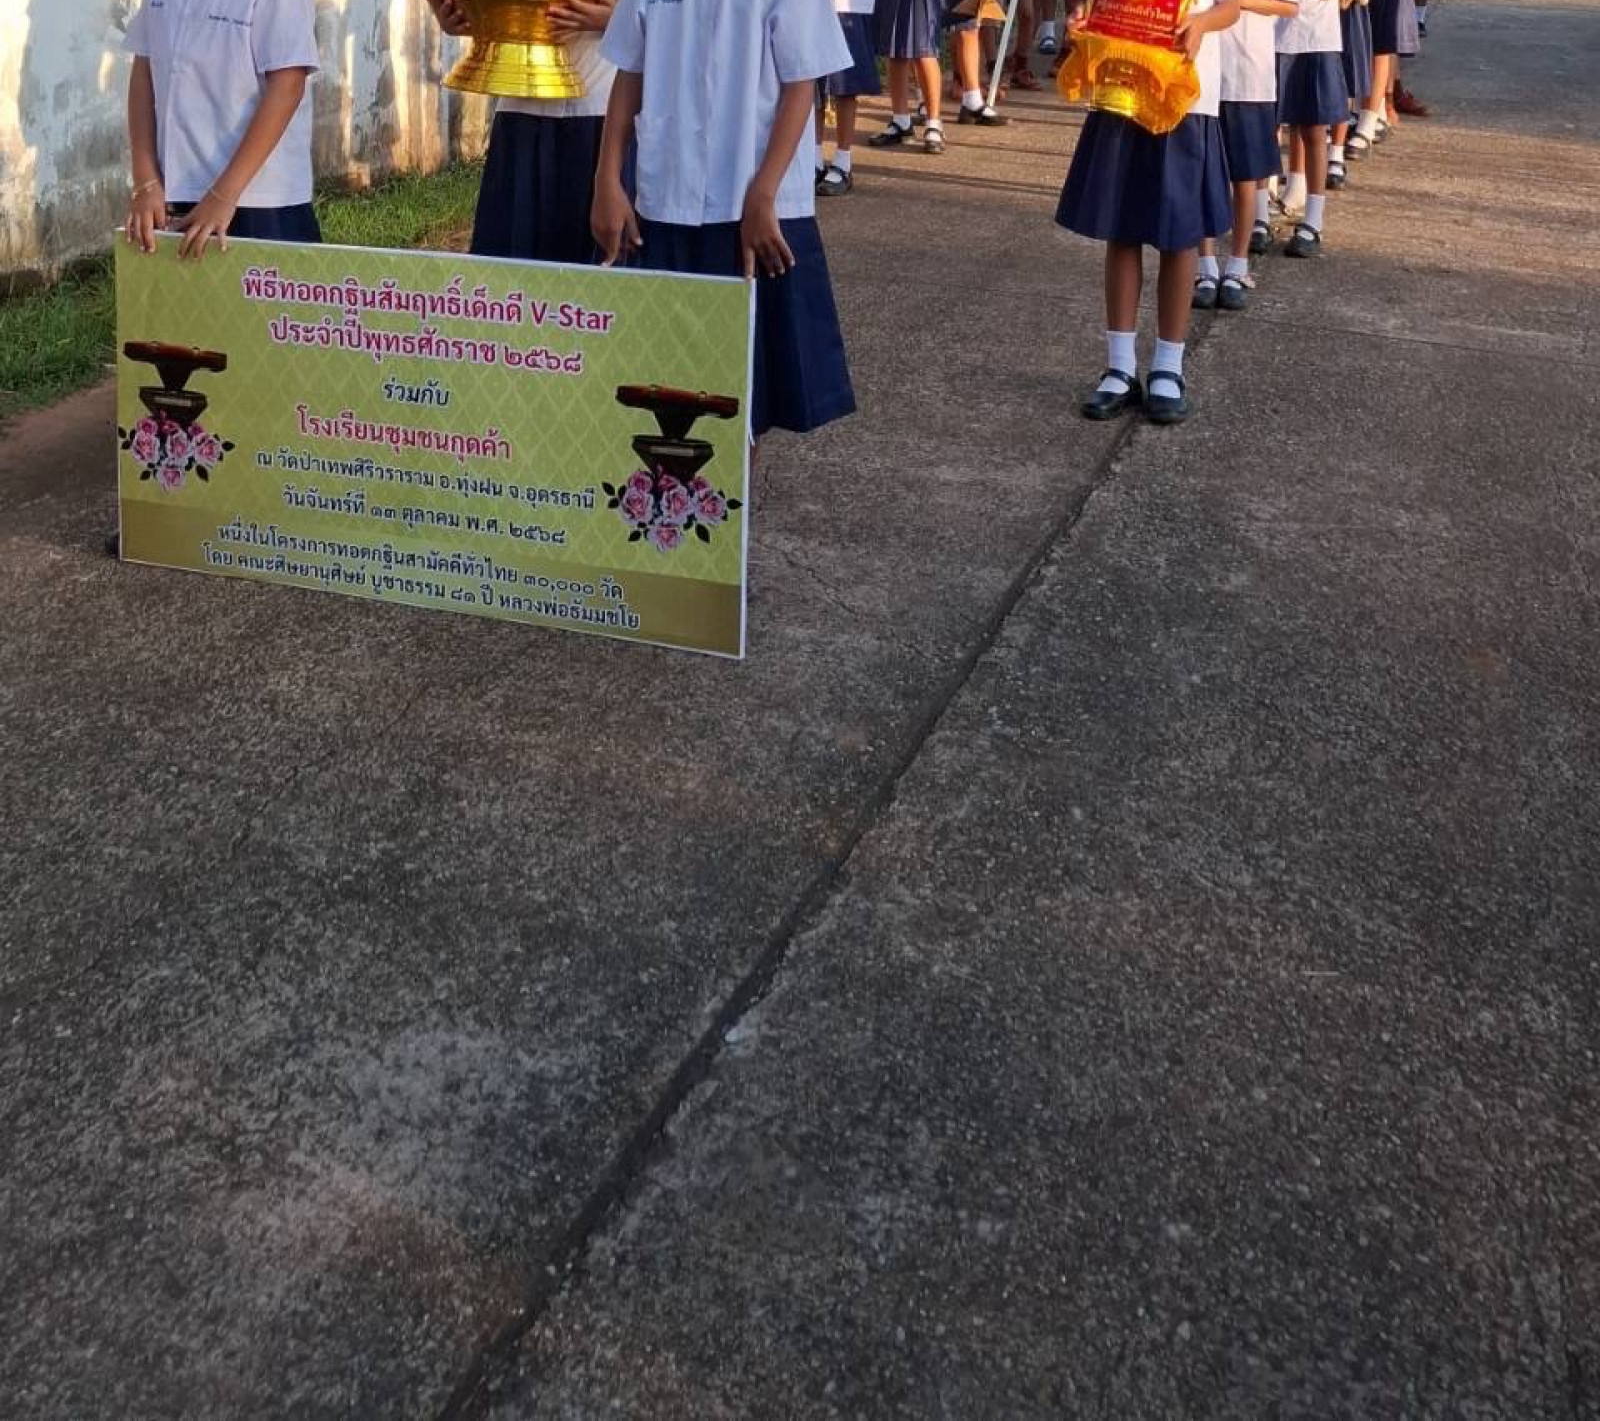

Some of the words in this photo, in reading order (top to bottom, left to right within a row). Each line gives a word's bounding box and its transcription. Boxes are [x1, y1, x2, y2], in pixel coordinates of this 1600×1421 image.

[244, 268, 523, 323] พิธีทอดกฐินสัมฤทธิ์เด็กดี
[531, 301, 615, 331] V-Star
[271, 315, 496, 363] ประจำปีพุทธศักราช
[504, 345, 582, 373] ๒๕๖๘
[384, 377, 450, 406] ร่วมกับ
[297, 405, 511, 463] โรงเรียนชุมชนกุดค้า
[257, 451, 272, 465] ณ
[440, 473, 503, 497] อ.ทุ่งฝน
[509, 485, 595, 509] จ.อุดรธานี
[283, 483, 366, 514] วันจันทร์ที่
[371, 505, 396, 519] ๑๓
[402, 507, 459, 529] ตุลาคม
[467, 516, 504, 534] พ.ศ.
[509, 522, 566, 544] ๒๕๖๘
[203, 541, 232, 565] โดย
[238, 554, 366, 586] คณะศิษยานุศิษย์
[371, 574, 446, 598] บูชาธรรม
[451, 587, 476, 603] ๘๑
[480, 583, 494, 606] ปี
[499, 594, 640, 629] หลวงพ่อธัมมชโย
[523, 575, 595, 595] ๓๐,๐๐๐
[600, 577, 623, 599] วัด
